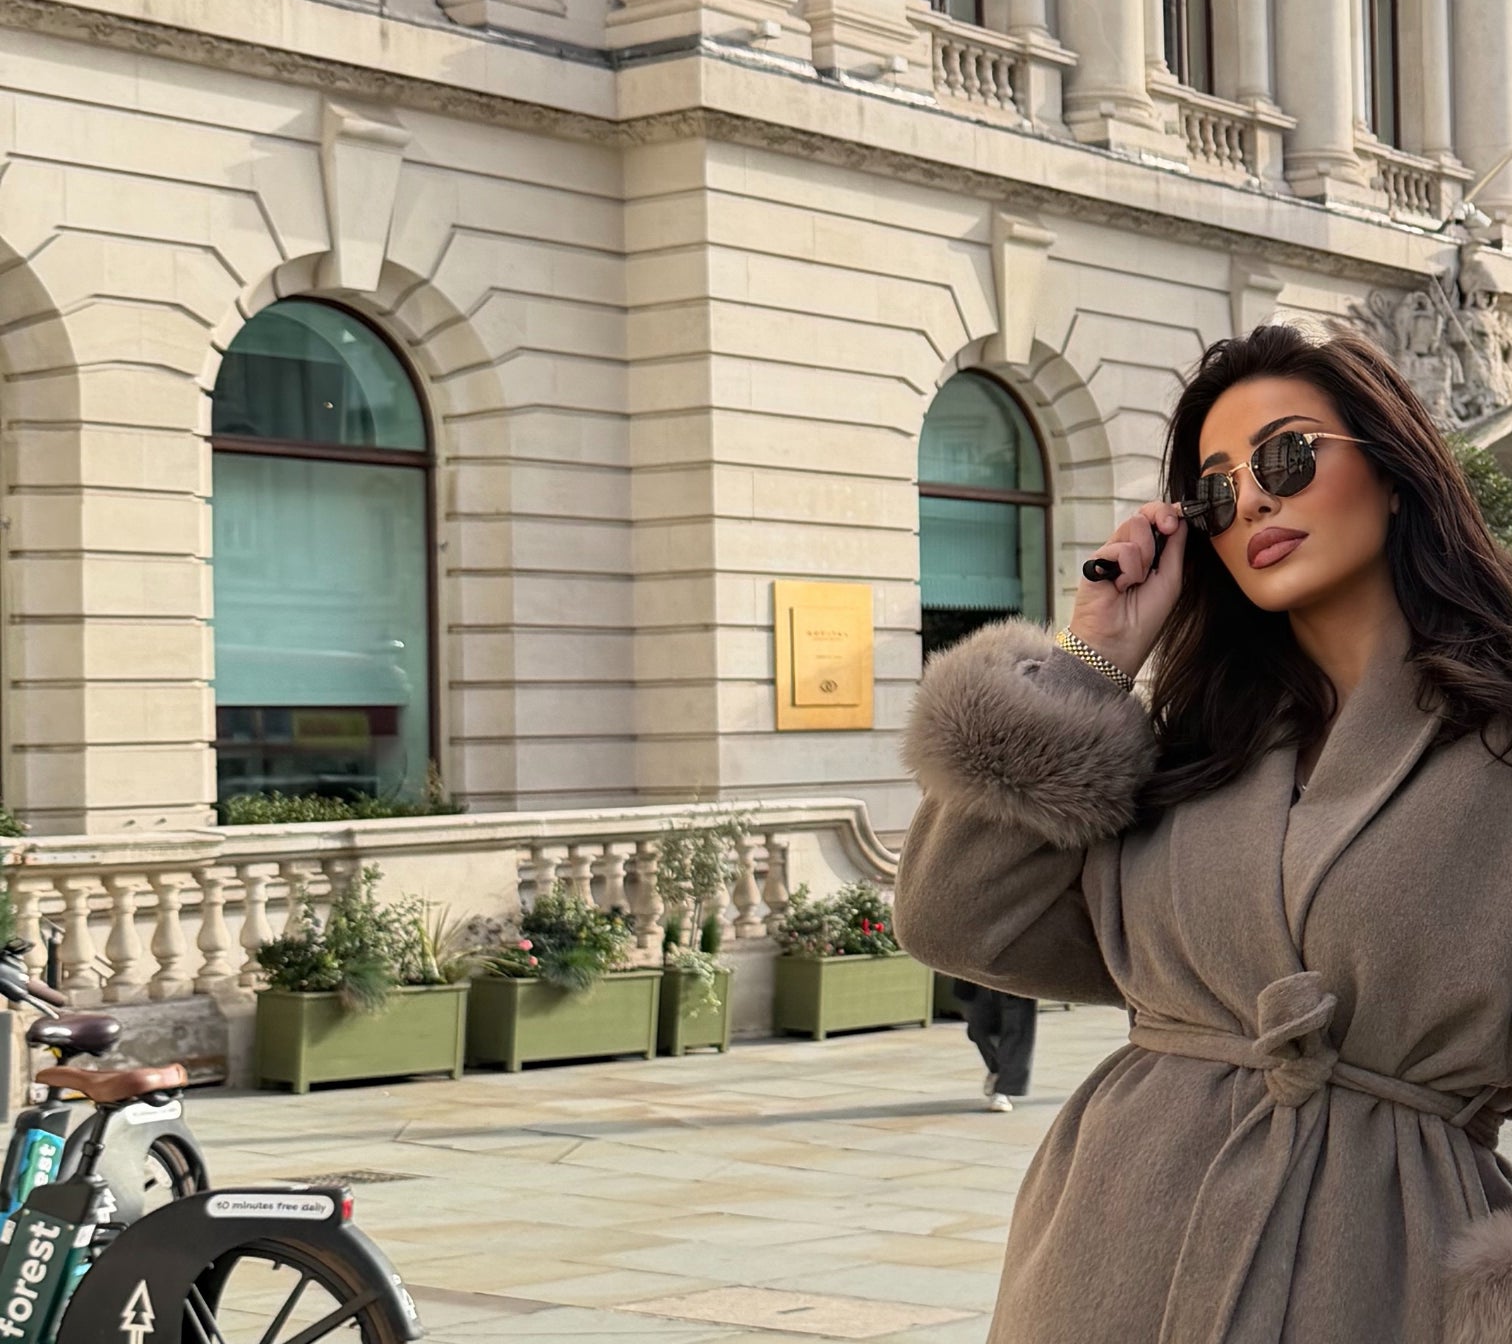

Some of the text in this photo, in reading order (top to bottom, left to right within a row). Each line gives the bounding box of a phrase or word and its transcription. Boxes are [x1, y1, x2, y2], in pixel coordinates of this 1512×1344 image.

[34, 1143, 57, 1187] est
[231, 1200, 274, 1210] minutes
[277, 1201, 299, 1210] free
[301, 1201, 327, 1215] daily
[0, 1220, 61, 1339] forest
